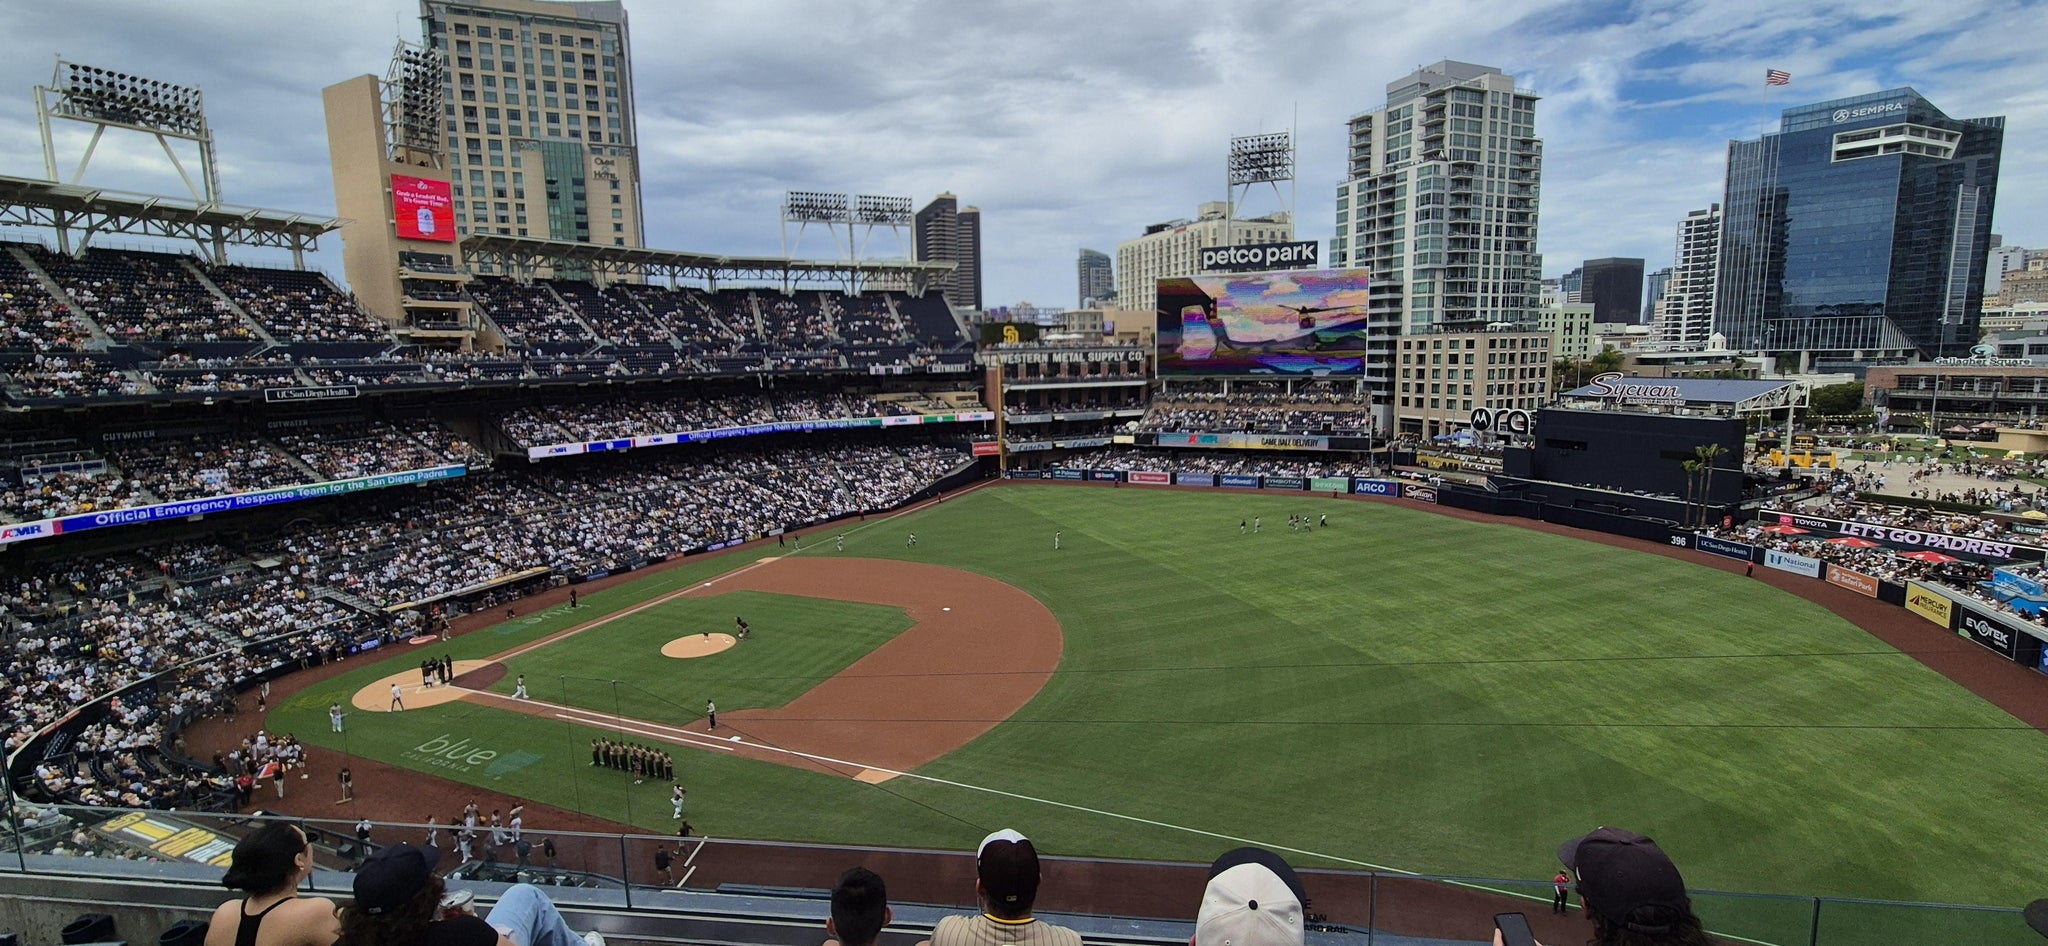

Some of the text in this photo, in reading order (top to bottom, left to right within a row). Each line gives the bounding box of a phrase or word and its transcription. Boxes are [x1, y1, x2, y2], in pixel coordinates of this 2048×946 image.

[1851, 102, 1903, 118] SEMPRA
[1202, 243, 1316, 269] petco park
[1000, 351, 1144, 364] WESTERN METAL SUPPLY CO.
[1934, 356, 2032, 367] Gallagher Square
[932, 364, 966, 372] CUTWATER
[1588, 371, 1680, 404] Sycuan
[268, 419, 308, 428] CUTWATER
[102, 431, 155, 441] CUTWATER
[1222, 477, 1251, 485] Southwest
[1356, 483, 1386, 493] ARCO
[96, 469, 448, 525] Official Emergency Response Team for the San Diego Padres
[1405, 486, 1433, 500] Sycuan
[1795, 518, 1827, 529] TOYOTA
[2, 525, 42, 540] AMR
[1671, 535, 1686, 547] 396
[1839, 523, 2014, 559] LET'S GO PADRES!
[1784, 556, 1816, 569] National
[1858, 581, 1874, 592] Park
[1920, 594, 1948, 612] MERCURY
[1920, 602, 1947, 619] INSURANCE
[1966, 617, 2009, 645] EVOTEK
[414, 734, 497, 766] blue
[400, 751, 471, 773] CALIFORNIA
